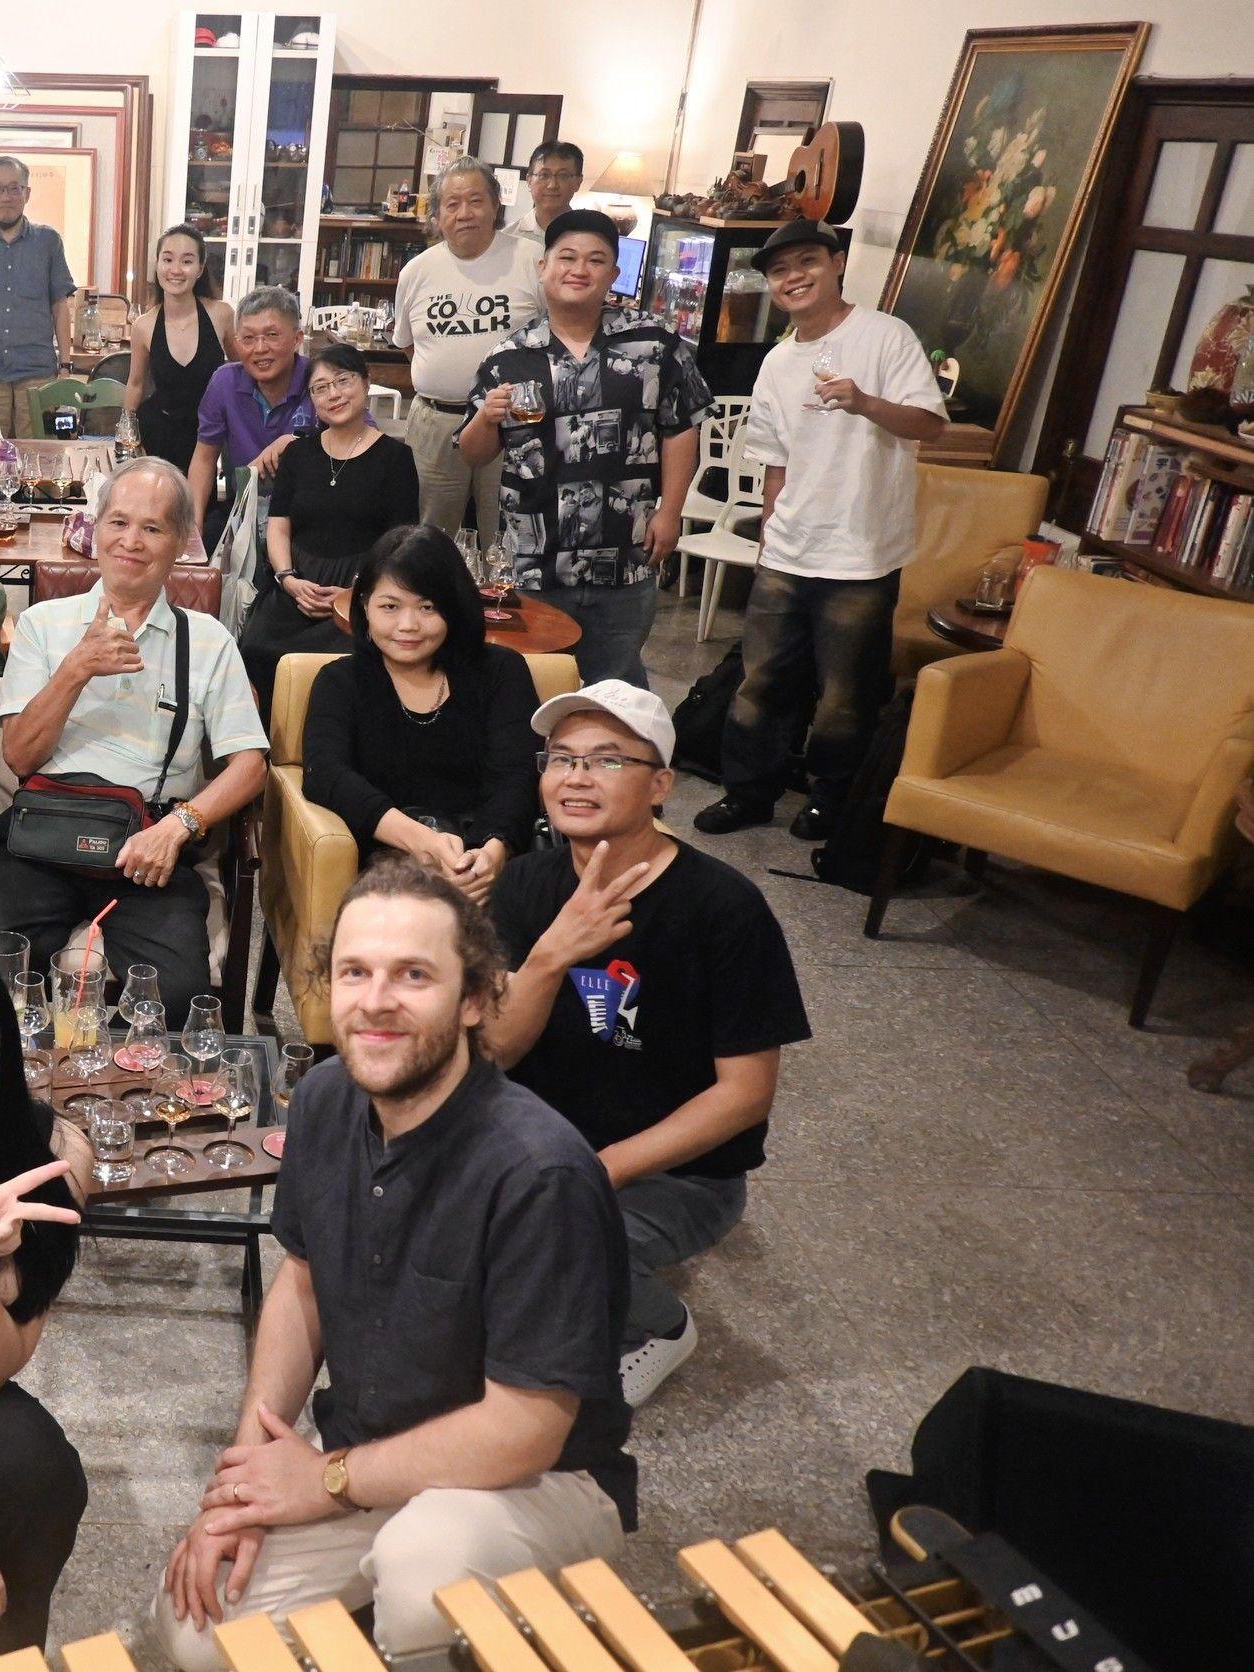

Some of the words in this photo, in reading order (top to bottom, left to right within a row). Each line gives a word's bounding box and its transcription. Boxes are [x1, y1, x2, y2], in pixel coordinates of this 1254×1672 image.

[429, 294, 452, 302] THE
[426, 314, 511, 335] WALK
[581, 975, 610, 991] ELLE
